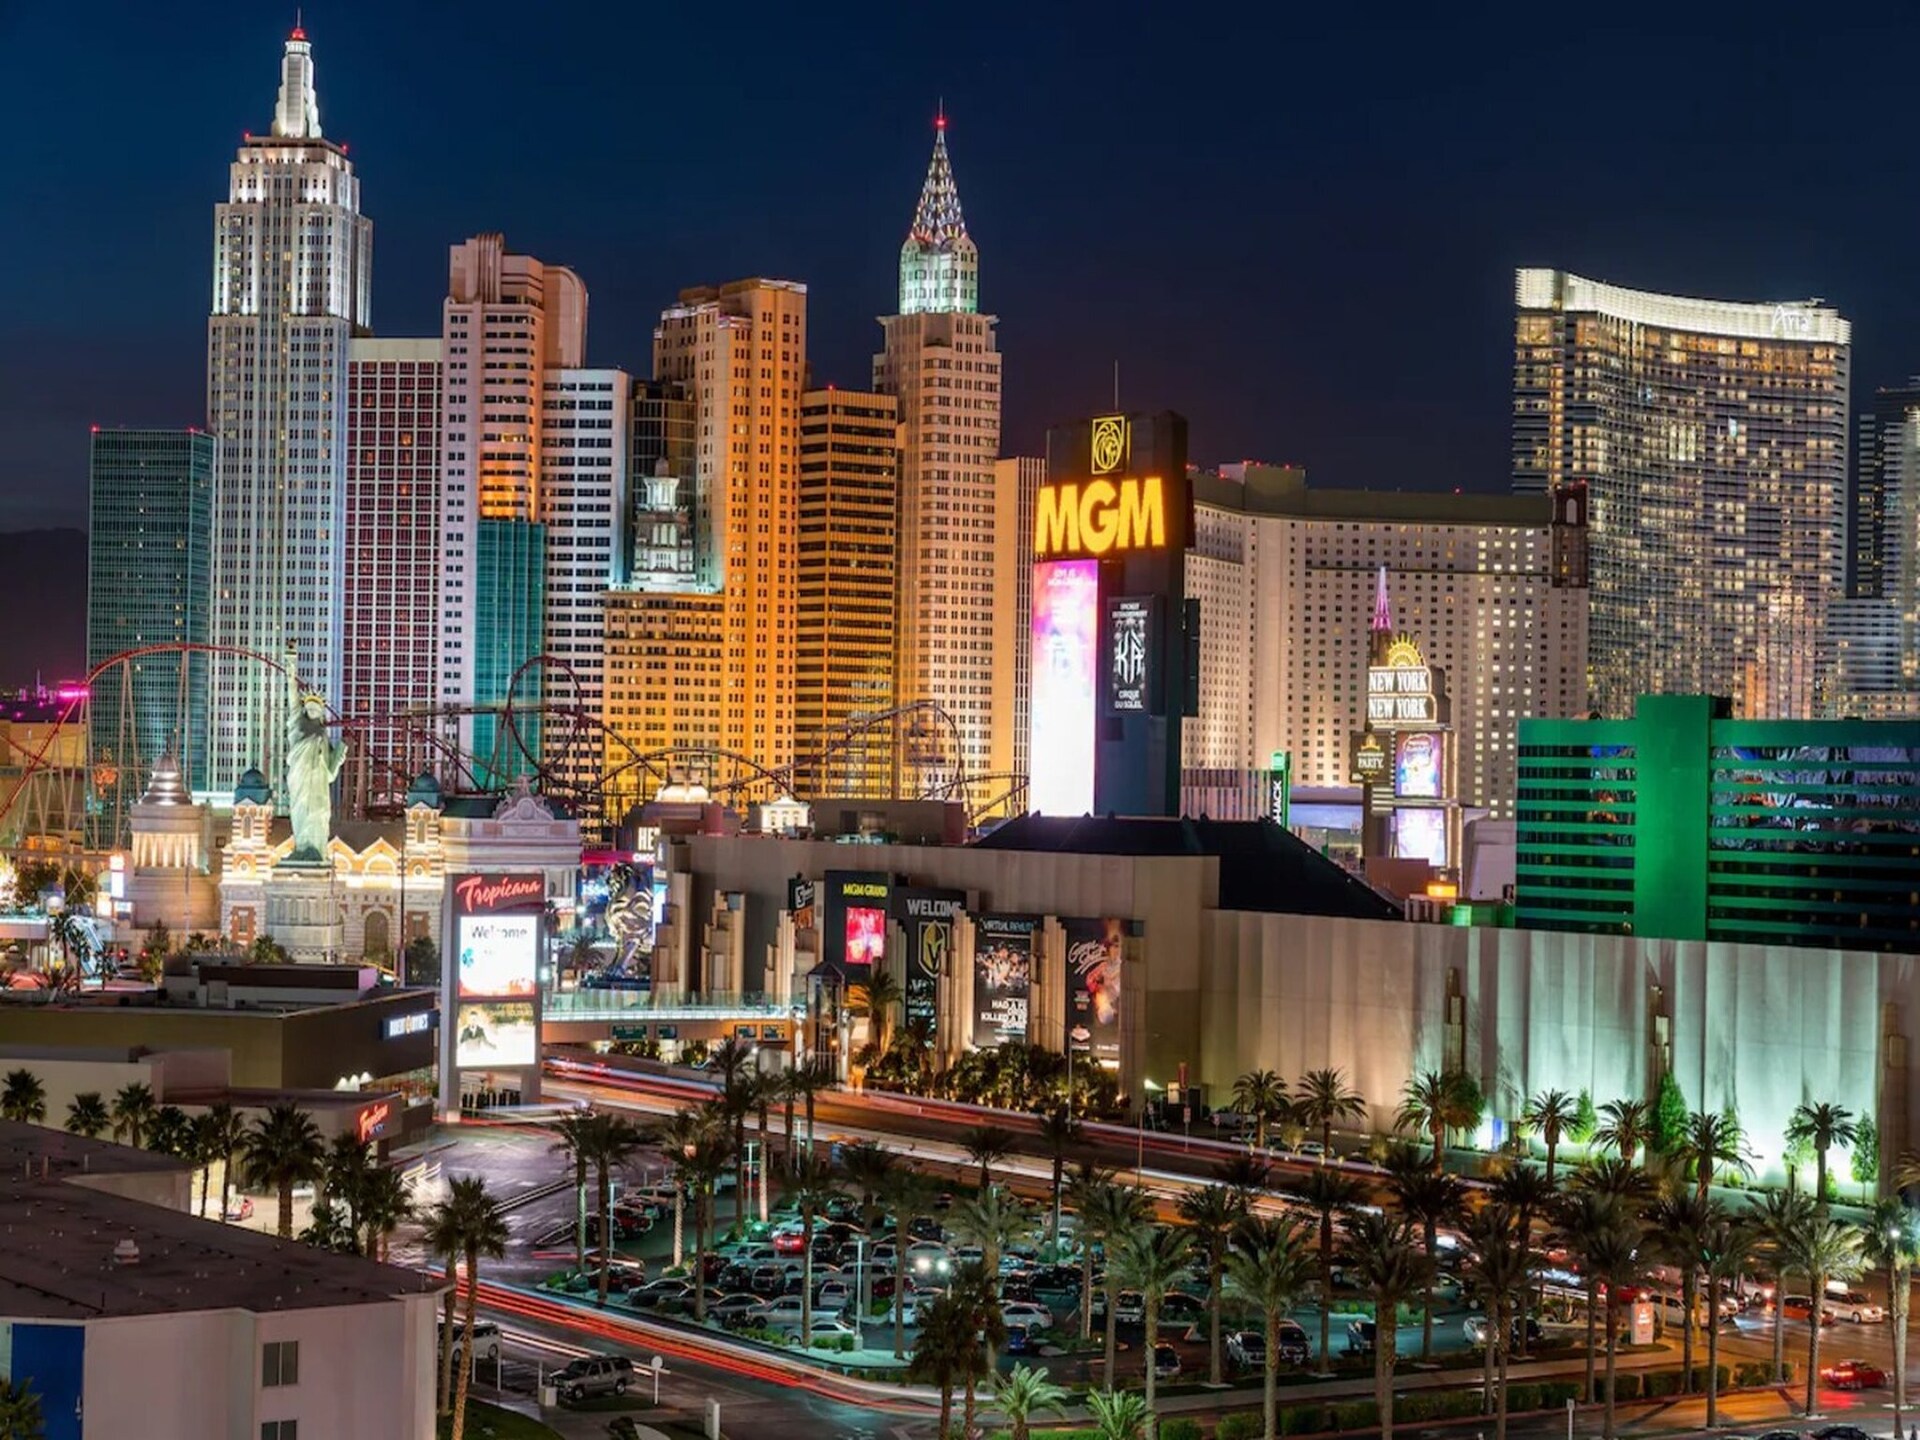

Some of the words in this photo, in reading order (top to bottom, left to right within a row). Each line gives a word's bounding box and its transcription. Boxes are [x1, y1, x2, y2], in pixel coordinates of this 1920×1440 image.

[1035, 477, 1165, 553] MGM
[1368, 671, 1395, 692] NEW
[1397, 671, 1428, 692] YORK
[1368, 697, 1395, 719] NEW
[1396, 697, 1428, 719] YORK
[456, 876, 541, 912] Tropicana
[843, 883, 864, 896] MGM
[864, 884, 888, 897] GRAND
